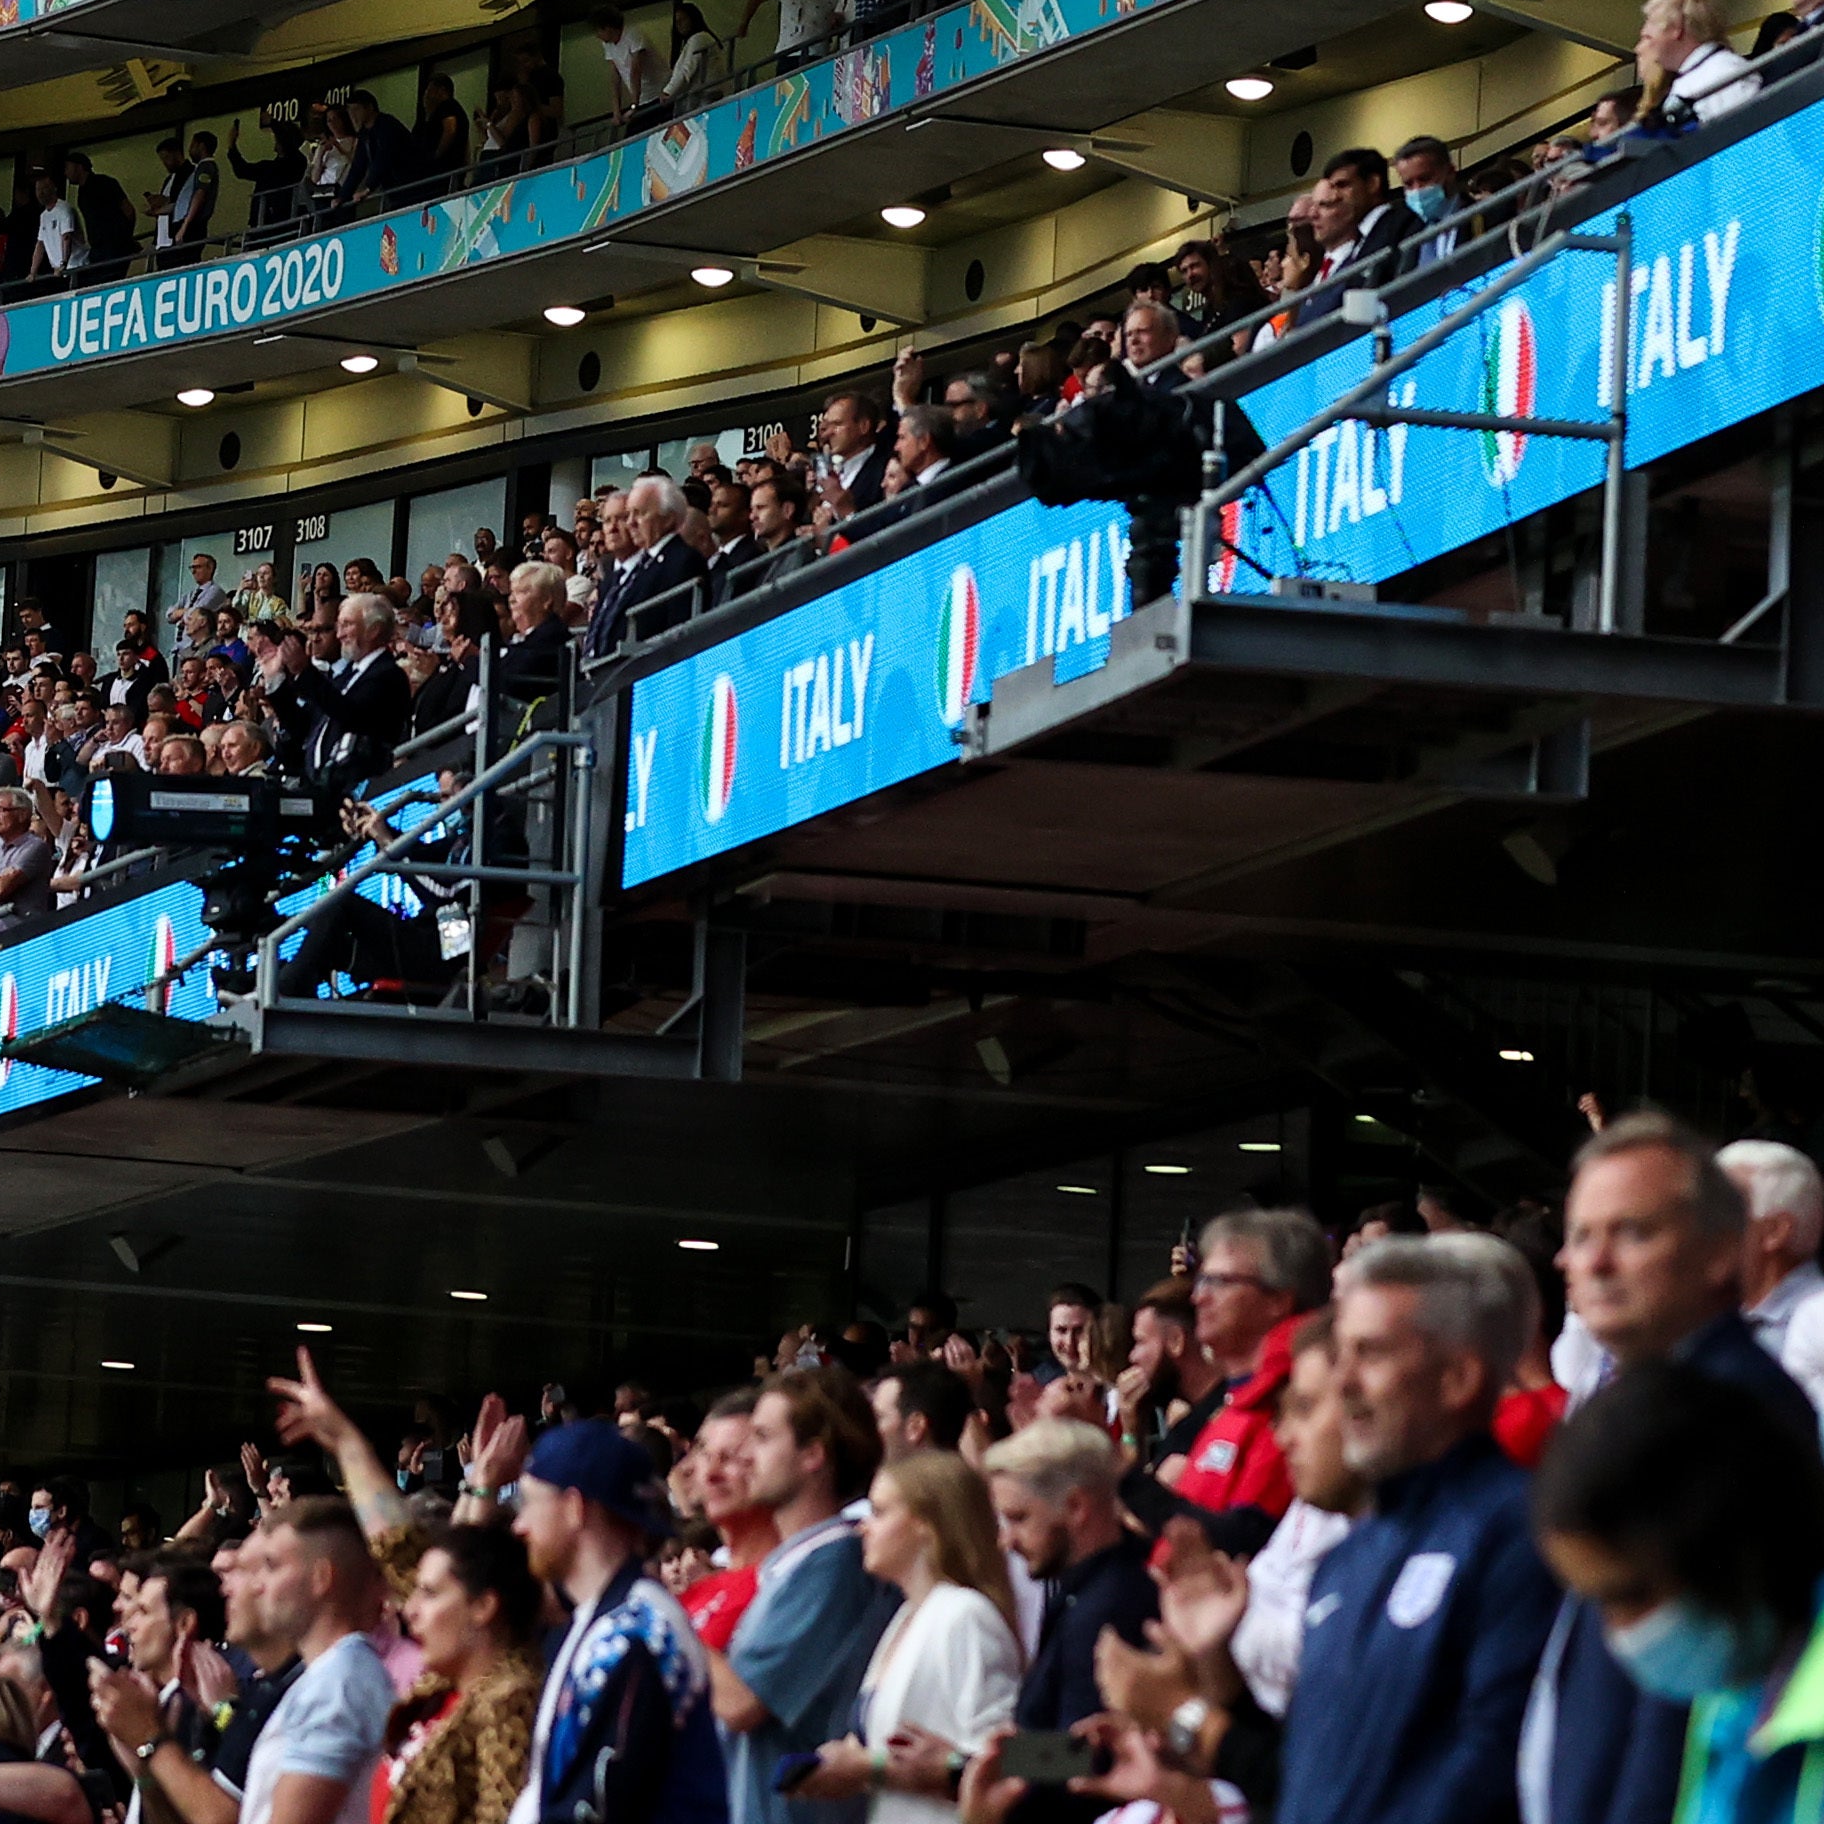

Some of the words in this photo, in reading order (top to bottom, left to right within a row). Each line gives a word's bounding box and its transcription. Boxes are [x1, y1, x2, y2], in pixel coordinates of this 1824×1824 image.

[52, 298, 147, 359] UEFA
[155, 263, 259, 339] EURO
[264, 239, 344, 312] 2020
[237, 524, 273, 550] 3107
[296, 515, 327, 541] 3108
[1025, 522, 1133, 668] ITALY
[780, 633, 874, 768] ITALY
